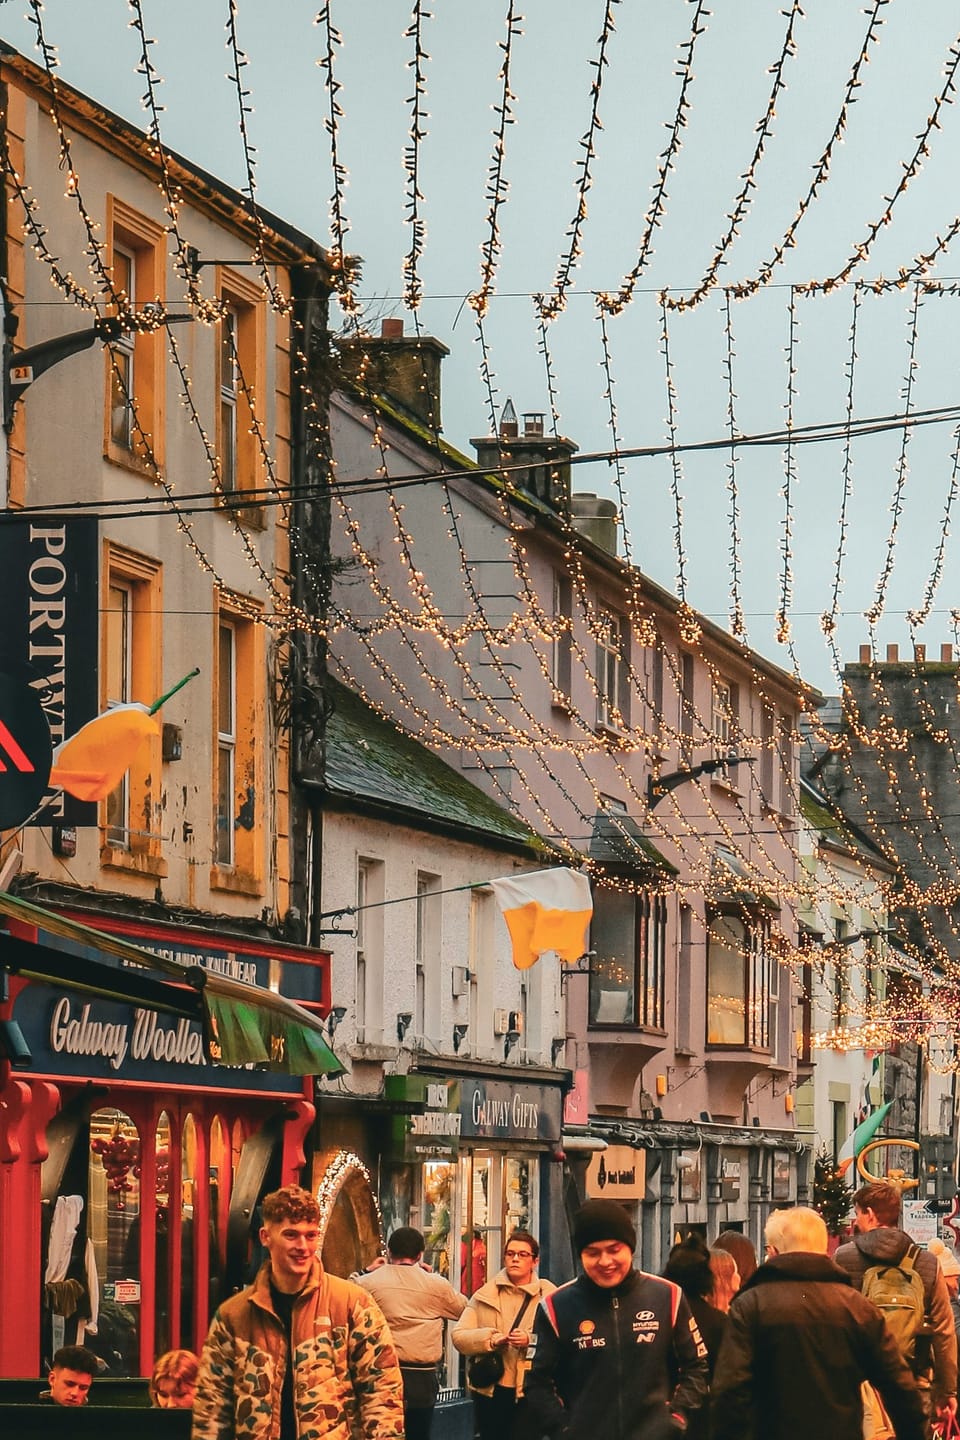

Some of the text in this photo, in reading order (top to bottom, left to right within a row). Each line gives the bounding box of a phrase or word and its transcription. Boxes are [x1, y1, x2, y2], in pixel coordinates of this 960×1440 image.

[28, 524, 67, 818] PORTWT
[52, 997, 128, 1070] Galway
[472, 1089, 510, 1127] GALWAY
[512, 1093, 538, 1129] GIFTS
